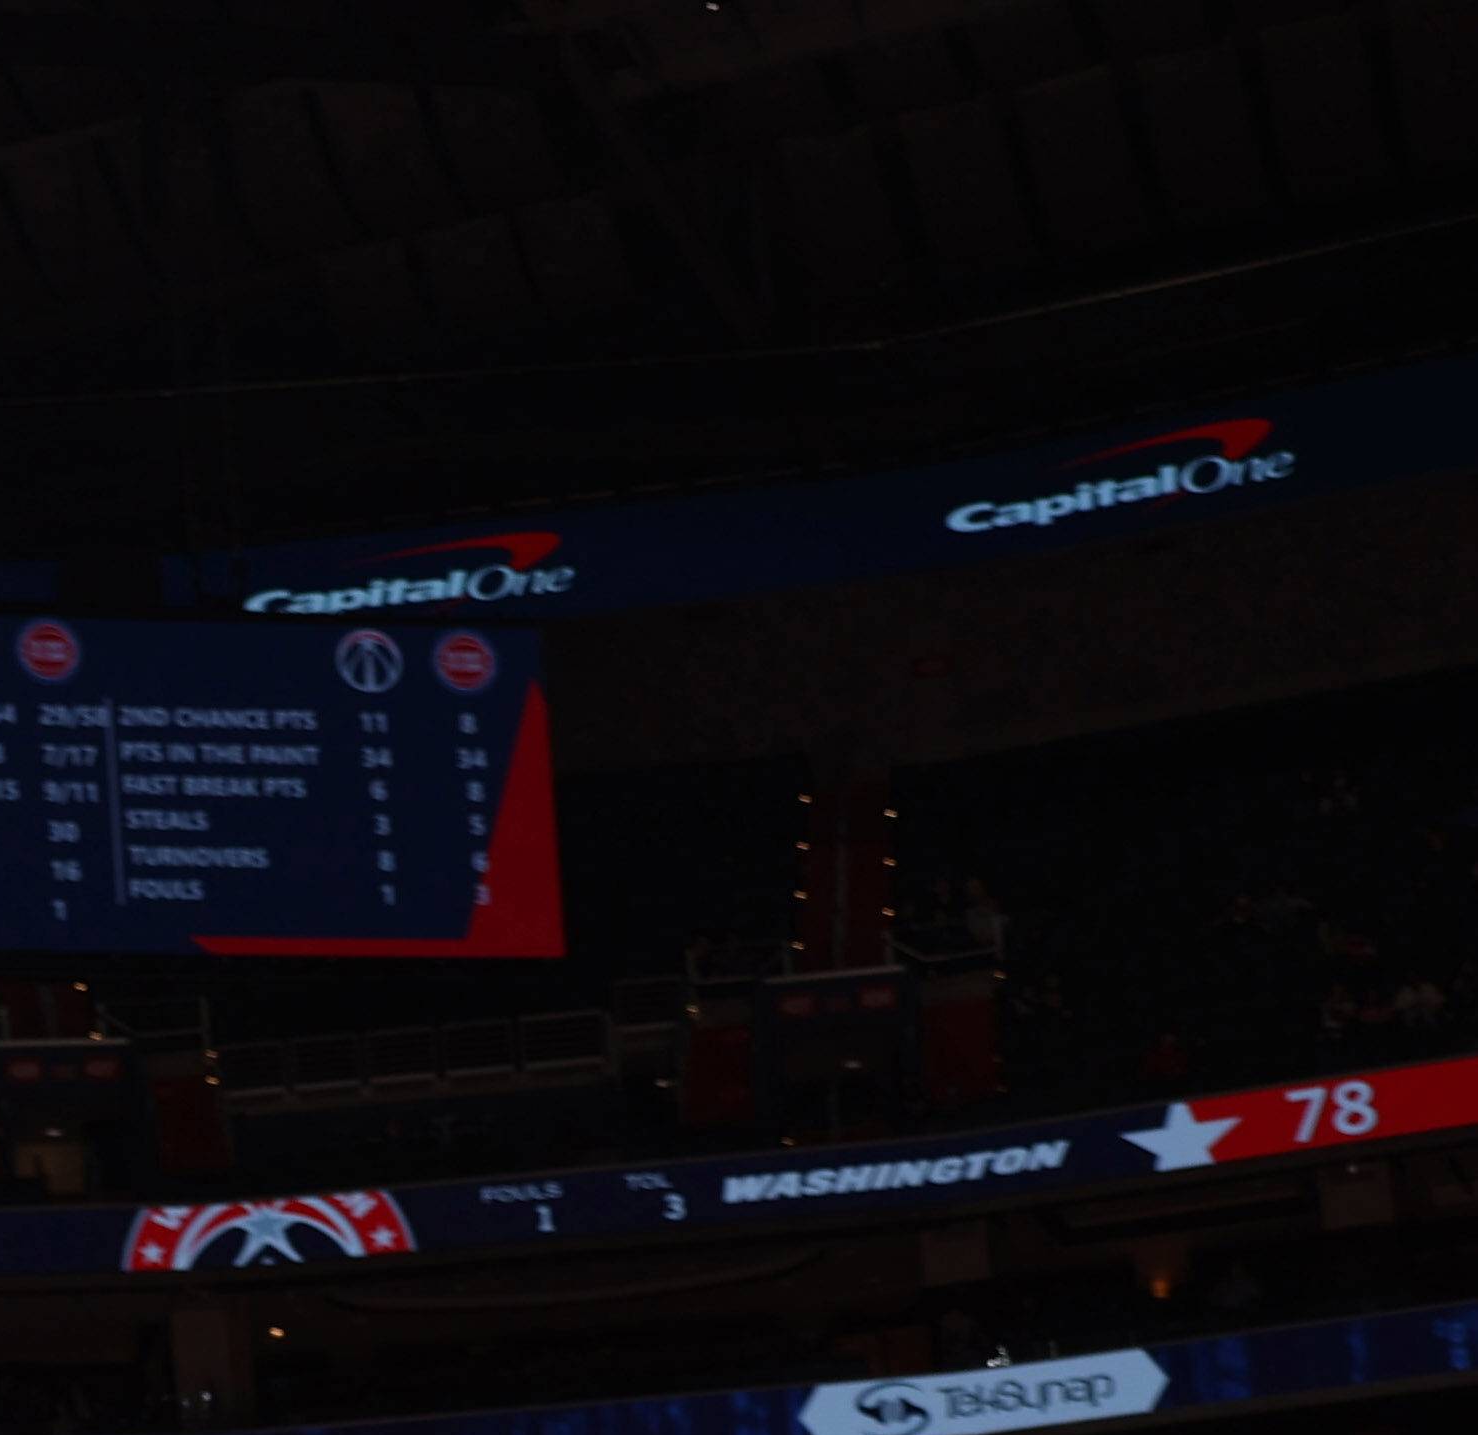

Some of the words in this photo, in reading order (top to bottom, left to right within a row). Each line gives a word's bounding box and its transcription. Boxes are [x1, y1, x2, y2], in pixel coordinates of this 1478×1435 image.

[272, 709, 319, 731] PTS
[119, 742, 164, 763] PTS
[121, 773, 178, 796] FAST
[180, 774, 259, 798] BREAK
[262, 776, 308, 799] PTS
[124, 808, 211, 831] STEALS
[128, 844, 272, 870] TURNOVERS
[128, 877, 205, 901] FOULS
[1283, 1079, 1378, 1145] 78
[722, 1139, 1072, 1205] WASHINGTON
[534, 1202, 556, 1234] 1
[661, 1192, 688, 1222] 3
